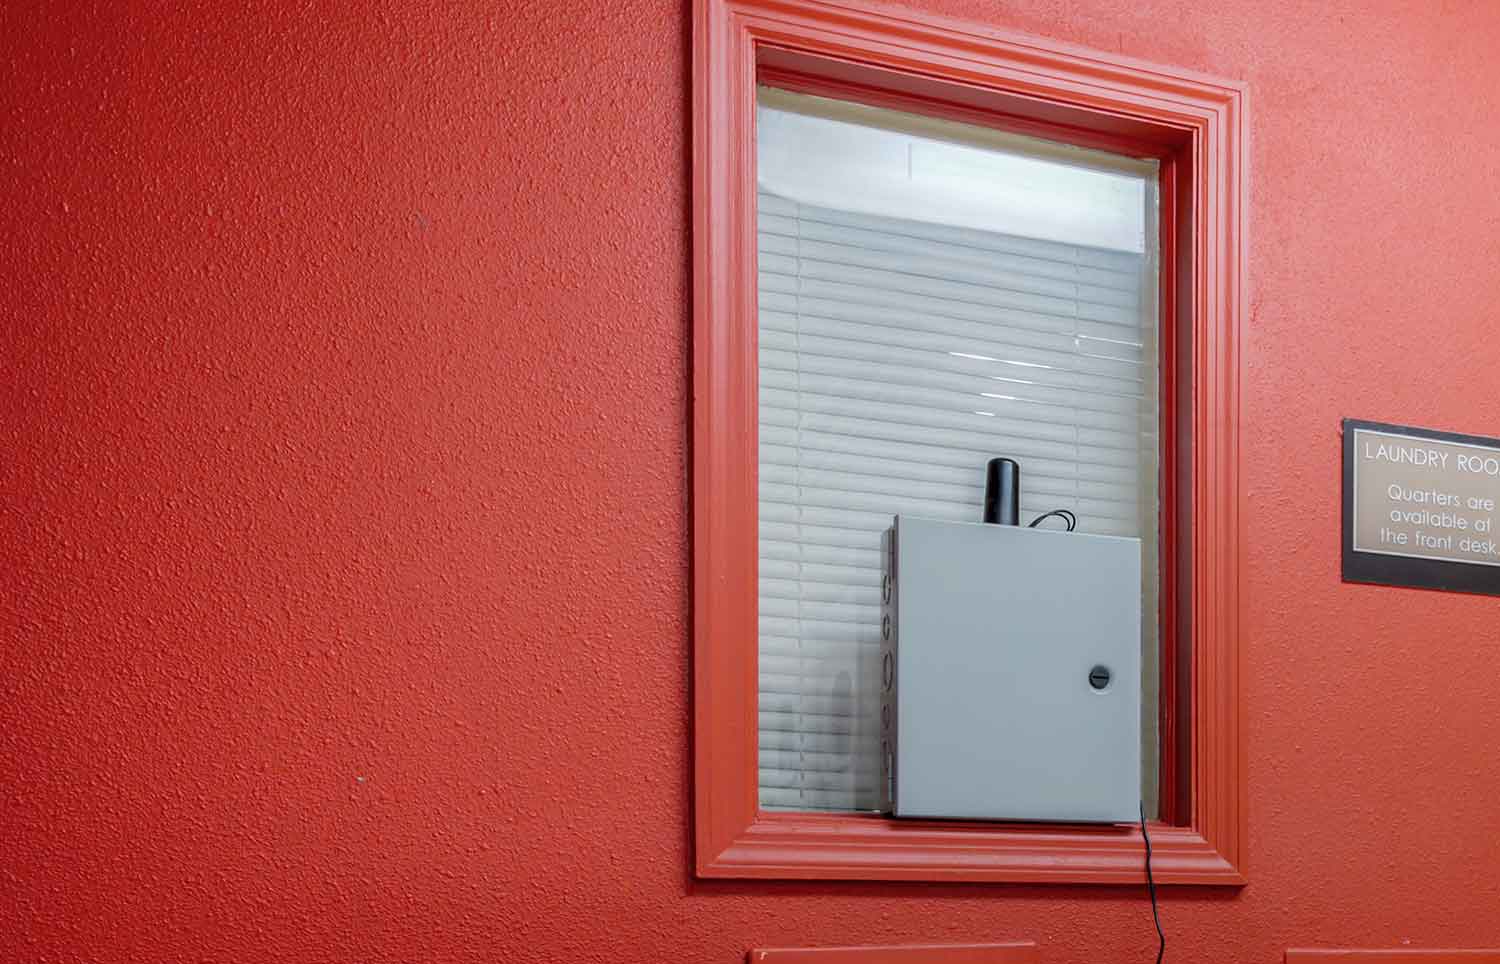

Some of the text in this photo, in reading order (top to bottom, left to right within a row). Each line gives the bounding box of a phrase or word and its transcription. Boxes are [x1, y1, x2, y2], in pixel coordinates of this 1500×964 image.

[1364, 442, 1448, 470] LAUNDRY
[1388, 484, 1495, 511] Quarters are
[1390, 510, 1492, 532] available at
[1379, 527, 1409, 544] the
[1415, 531, 1452, 550] front
